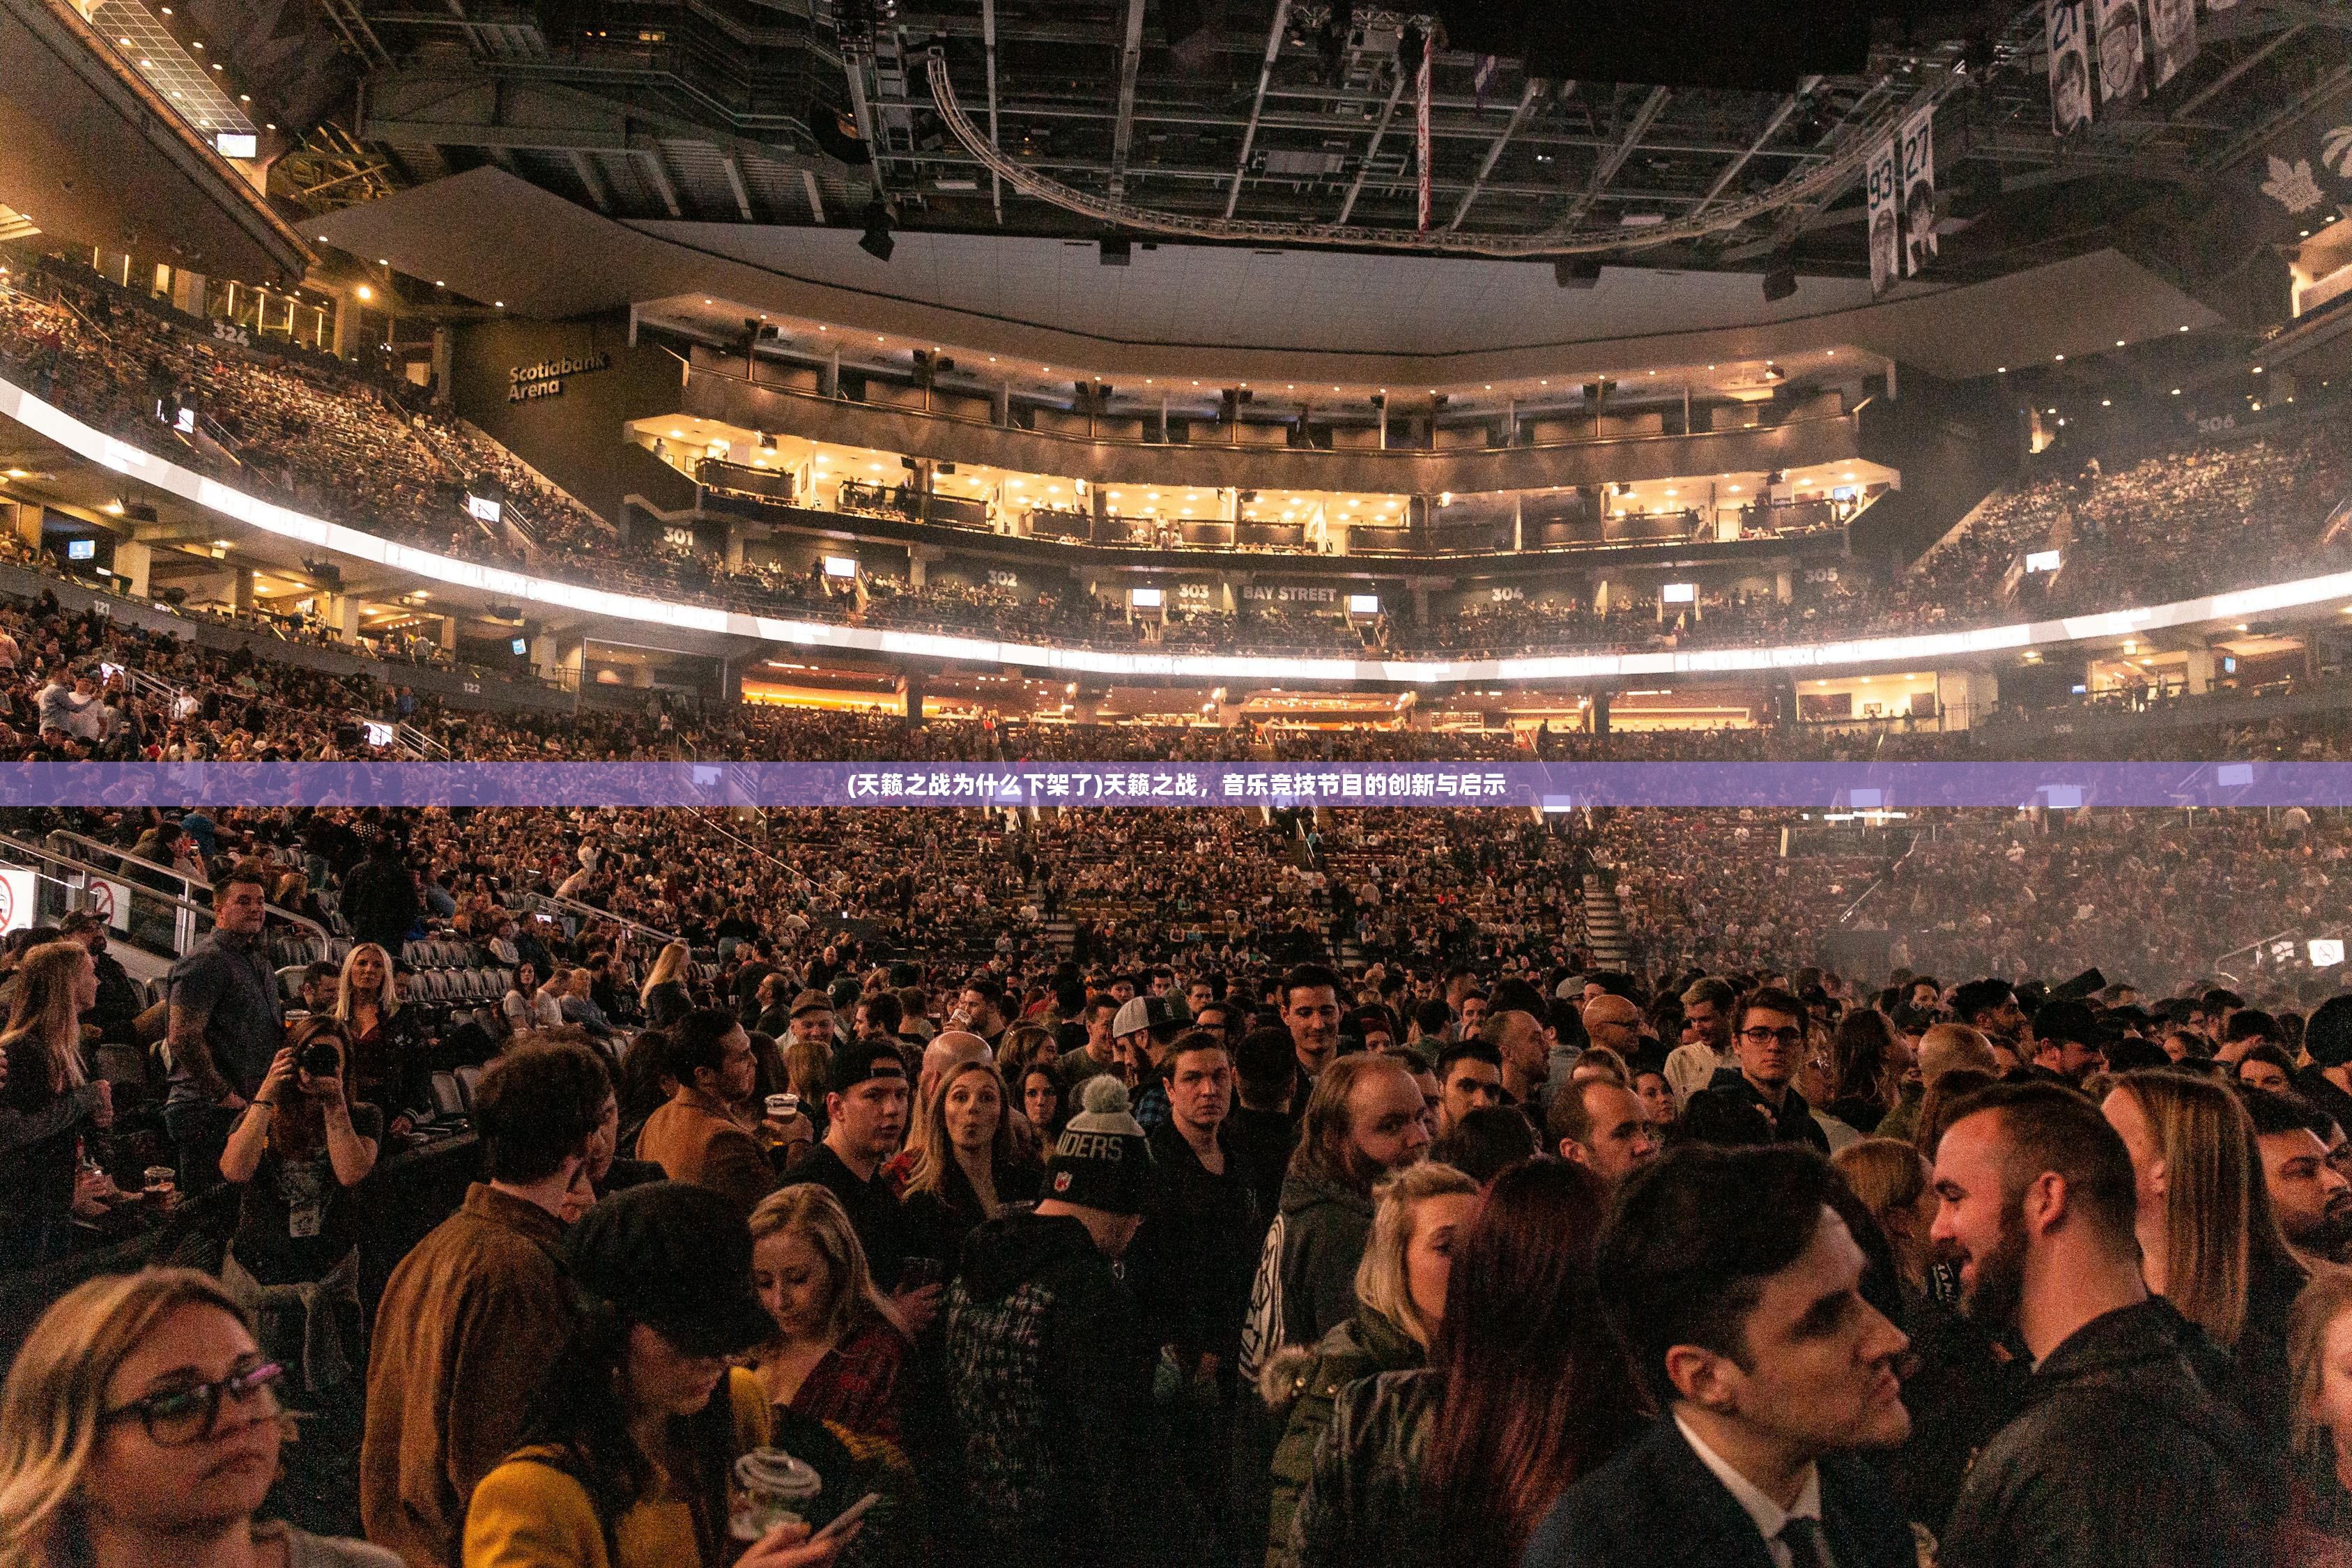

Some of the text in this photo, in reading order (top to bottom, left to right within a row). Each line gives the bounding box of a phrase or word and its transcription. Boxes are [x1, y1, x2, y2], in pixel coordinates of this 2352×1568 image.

[1905, 124, 1929, 183] 27
[1870, 158, 1892, 210] 93
[213, 320, 250, 348] 324
[509, 355, 607, 384] Scotiabank
[509, 380, 560, 401] Arena
[663, 527, 693, 546] 301
[989, 570, 1017, 587] 302
[1178, 583, 1210, 599] 303
[1243, 587, 1337, 601] BAY STREET
[1492, 587, 1524, 601] 304
